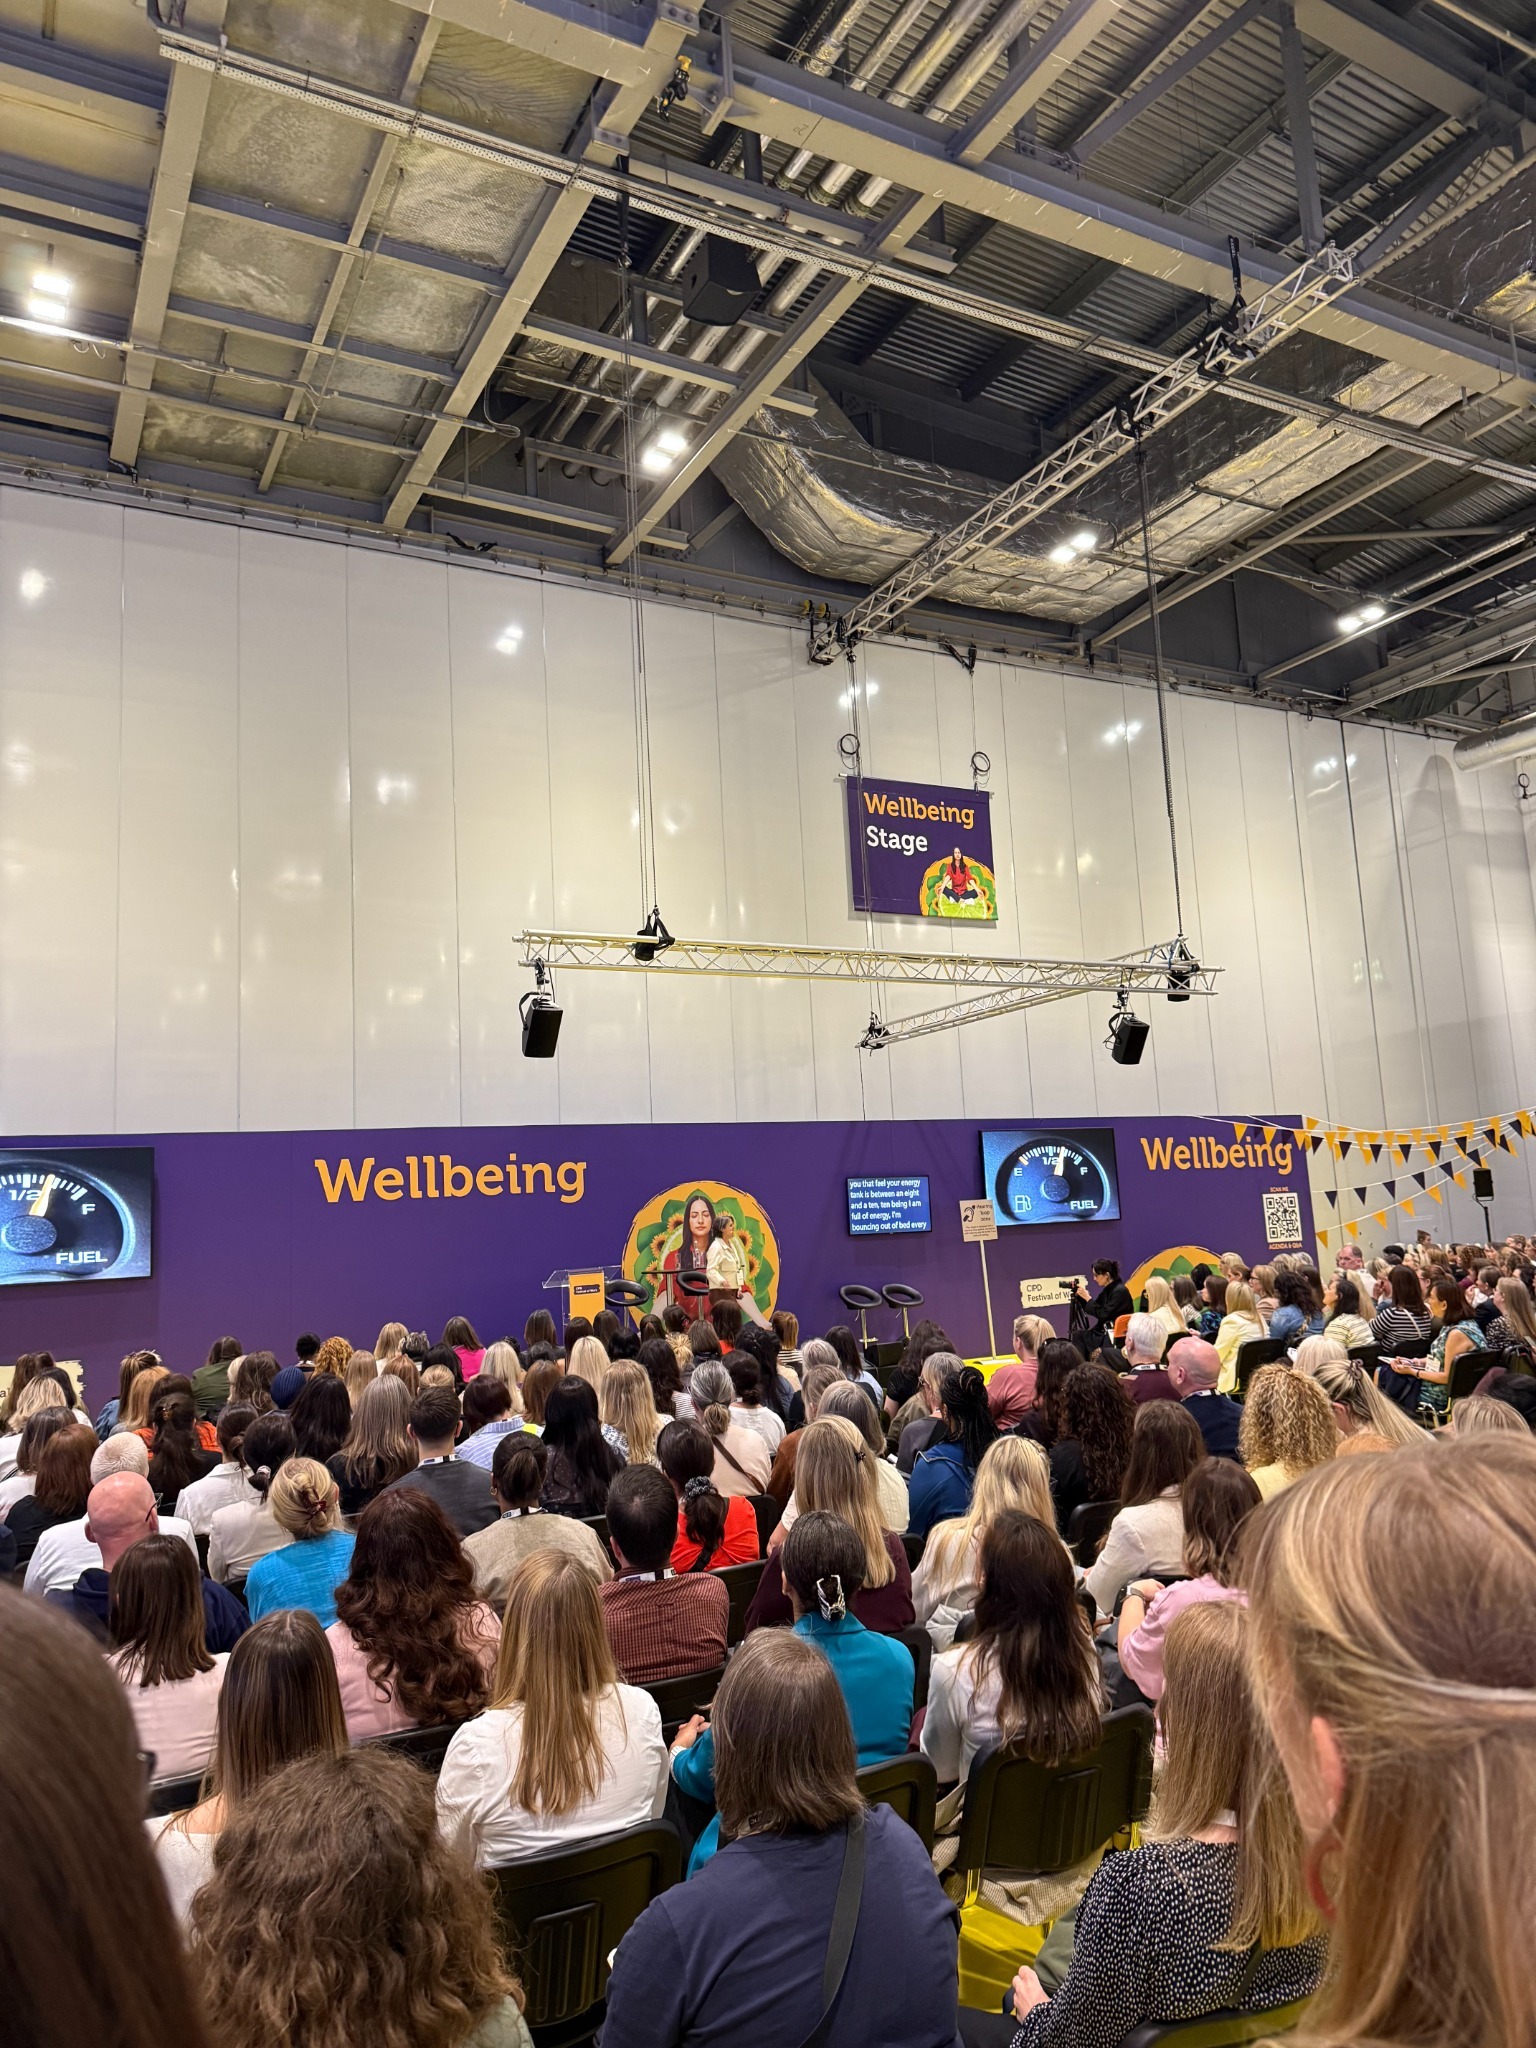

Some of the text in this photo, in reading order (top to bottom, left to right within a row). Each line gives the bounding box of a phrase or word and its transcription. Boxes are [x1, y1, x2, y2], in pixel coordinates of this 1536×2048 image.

[863, 792, 975, 829] Wellbeing
[866, 825, 928, 856] Stage
[1140, 1136, 1293, 1175] Wellbeing
[1013, 1167, 1023, 1176] E
[1080, 1167, 1088, 1175] F
[314, 1153, 587, 1203] Wellbeing
[850, 1179, 921, 1189] you that feel your energy
[850, 1191, 864, 1199] tank
[864, 1190, 869, 1198] is
[870, 1190, 895, 1198] between
[904, 1189, 920, 1198] eight
[82, 1203, 96, 1215] F
[891, 1200, 908, 1209] being
[1070, 1200, 1098, 1210] FUEL
[851, 1212, 861, 1220] full
[862, 1211, 869, 1219] of
[852, 1222, 879, 1231] bouncing
[891, 1221, 898, 1229] of
[899, 1221, 910, 1229] bed
[55, 1250, 108, 1264] FUEL
[1026, 1284, 1042, 1292] CIPD
[1027, 1292, 1053, 1302] Festival
